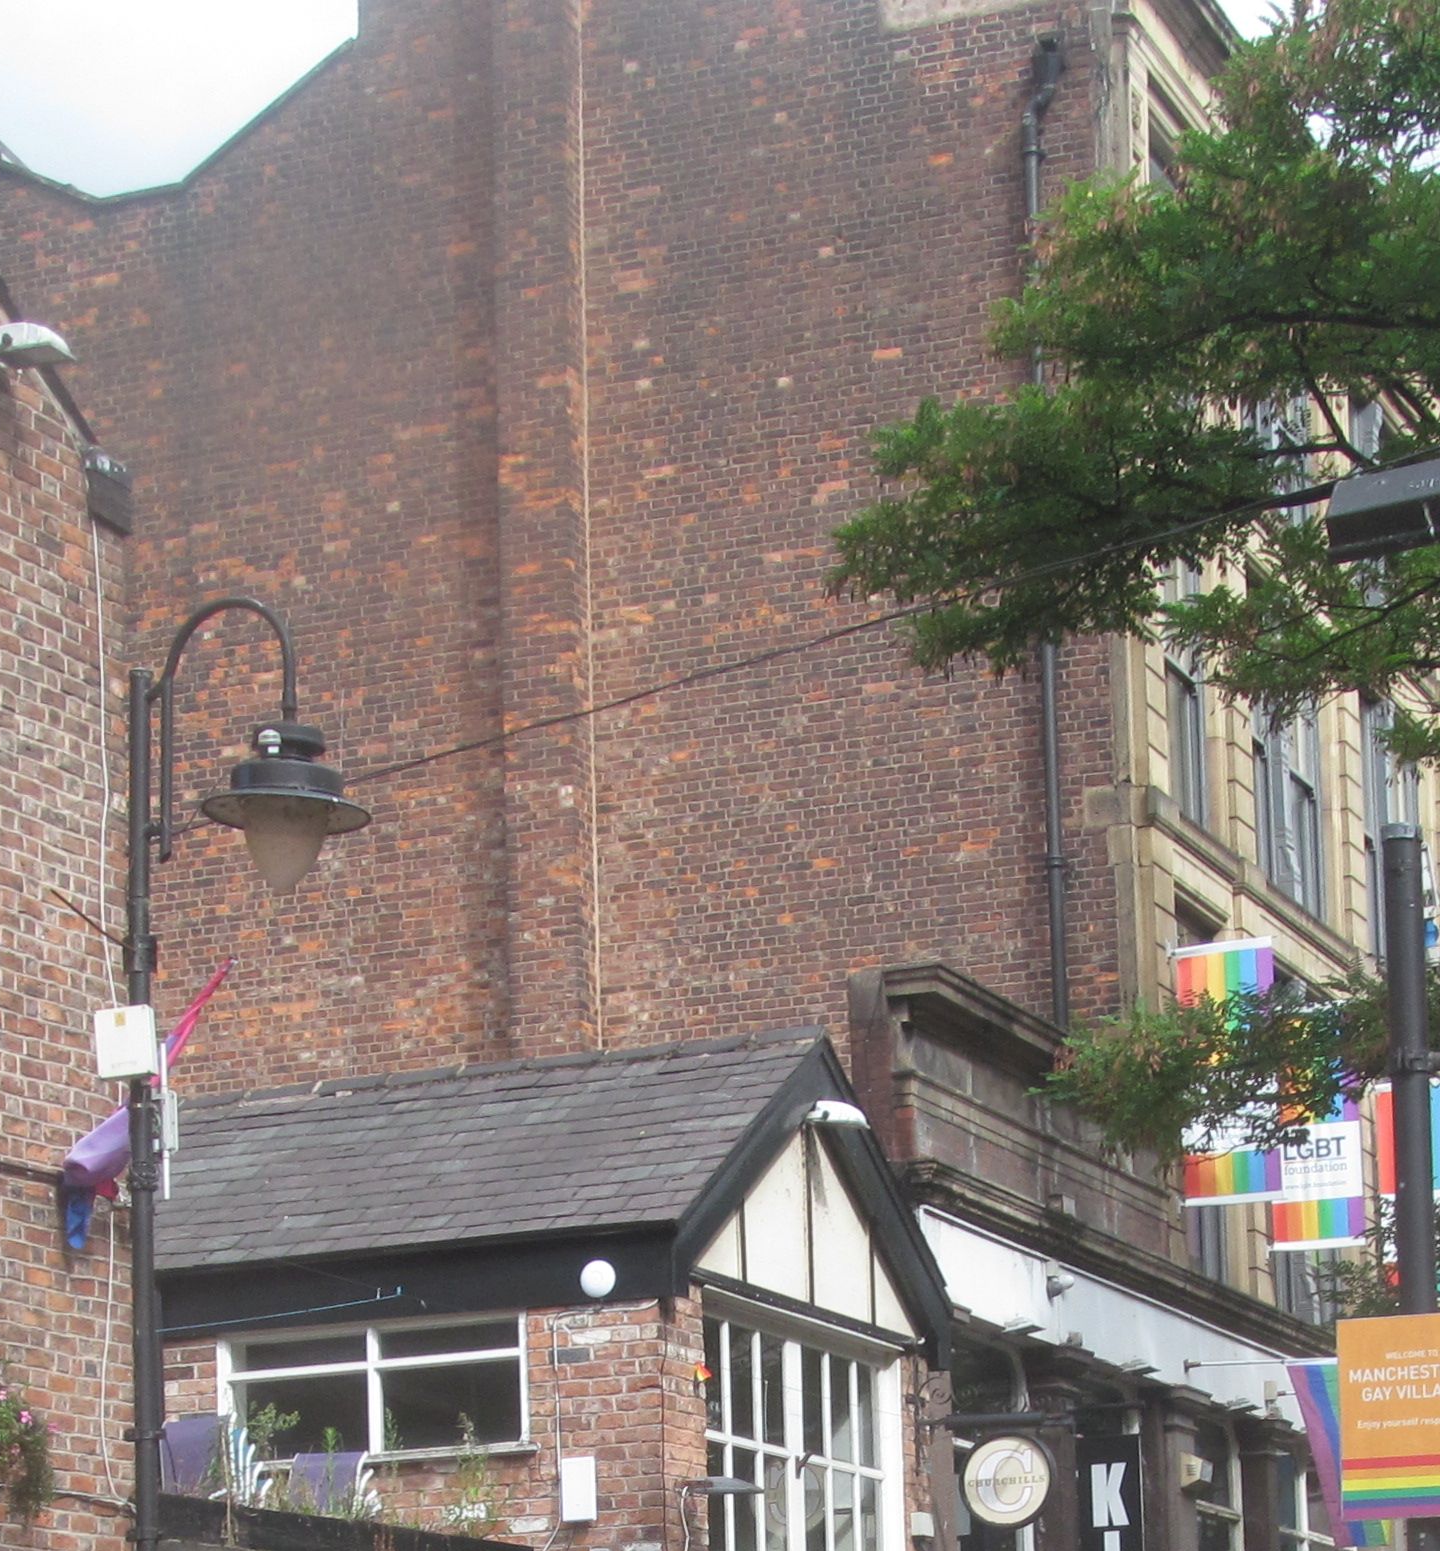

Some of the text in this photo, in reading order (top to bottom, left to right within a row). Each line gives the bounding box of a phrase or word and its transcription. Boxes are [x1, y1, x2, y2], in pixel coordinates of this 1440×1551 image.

[1283, 1136, 1346, 1161] LGBT
[1284, 1162, 1348, 1176] foundation
[1385, 1349, 1440, 1360] WELCOME TO
[1361, 1386, 1392, 1402] GAY
[1357, 1419, 1382, 1430] Enjoy
[1383, 1417, 1419, 1429] yourself
[967, 1474, 1046, 1488] CHURCHILLS
